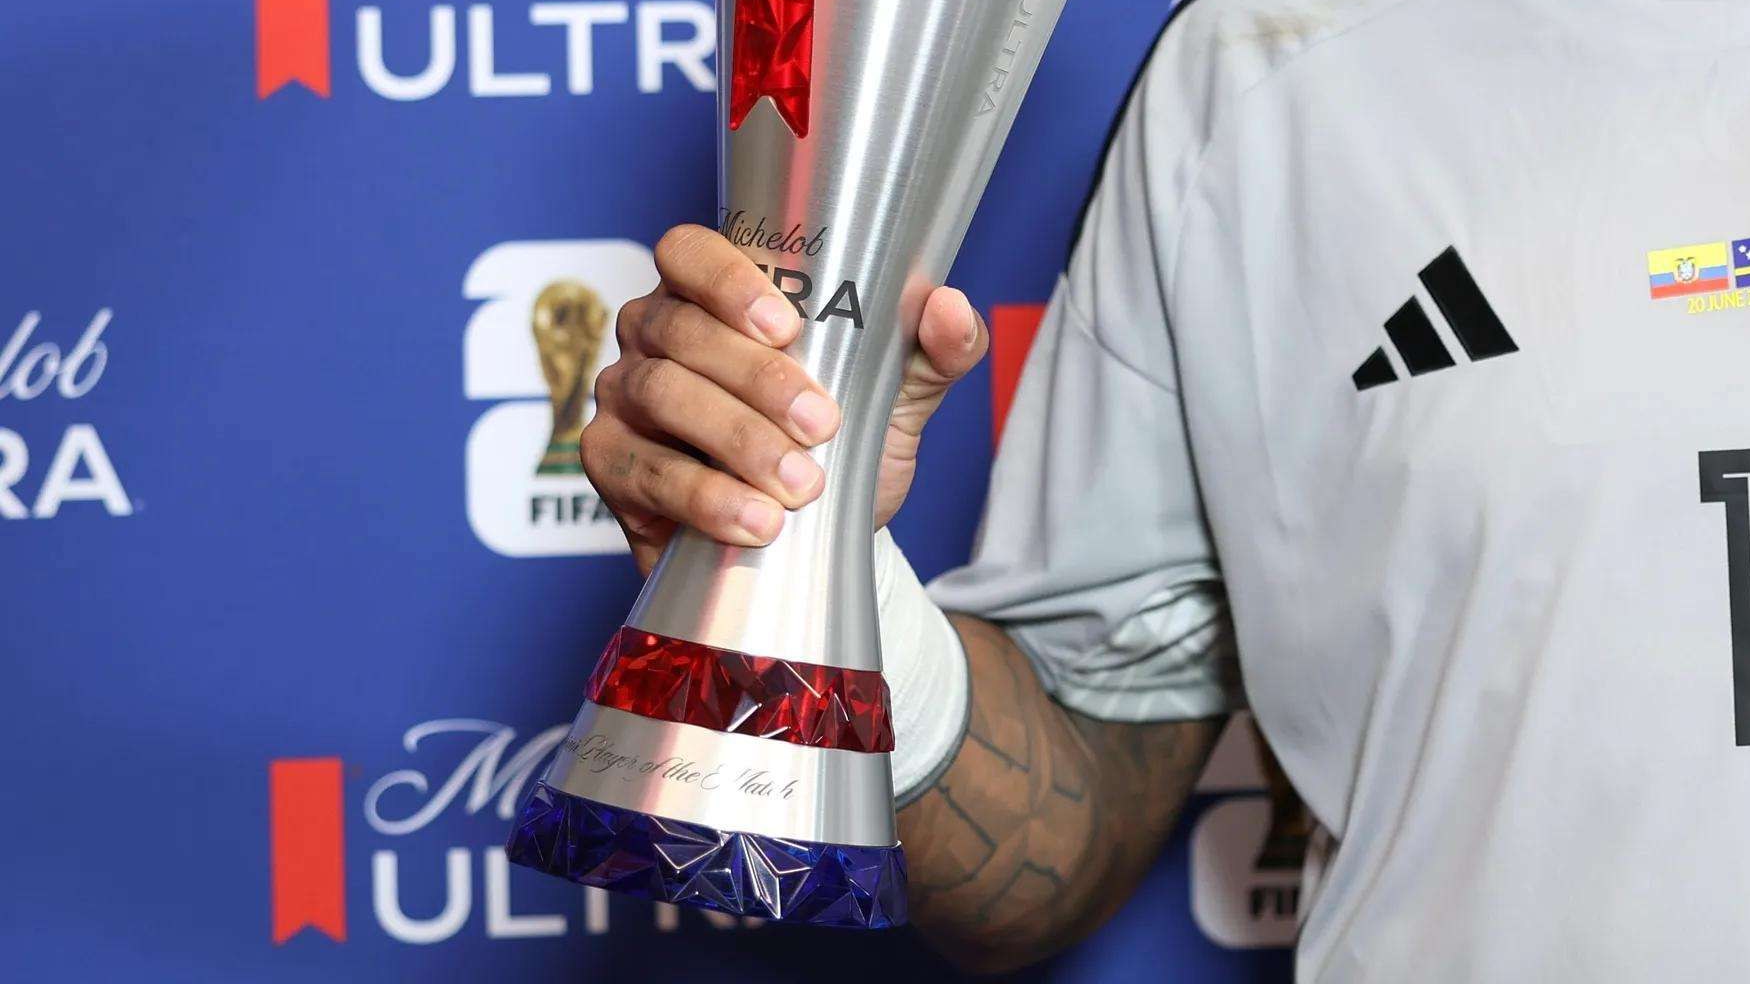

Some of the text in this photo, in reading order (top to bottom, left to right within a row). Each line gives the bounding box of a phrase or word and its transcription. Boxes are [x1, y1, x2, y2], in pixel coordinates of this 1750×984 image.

[1687, 296, 1705, 314] 20
[1707, 290, 1745, 312] JUNE
[661, 756, 702, 784] the
